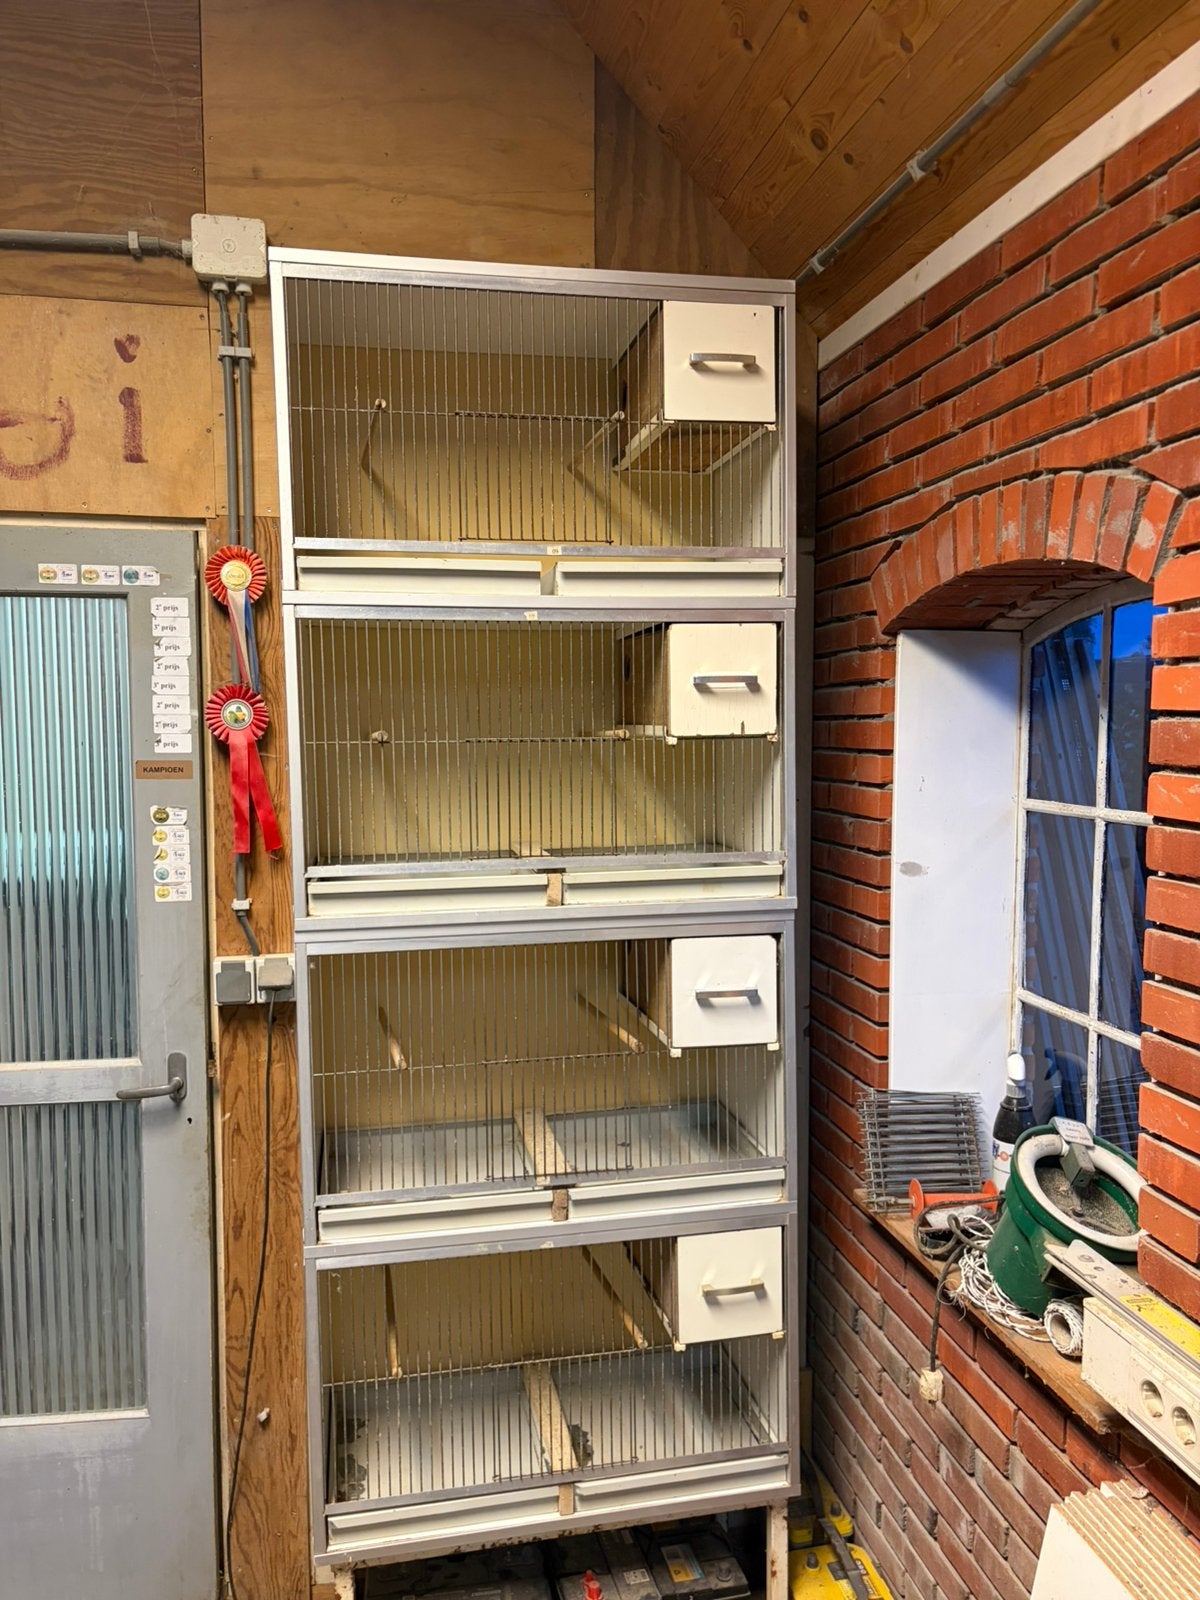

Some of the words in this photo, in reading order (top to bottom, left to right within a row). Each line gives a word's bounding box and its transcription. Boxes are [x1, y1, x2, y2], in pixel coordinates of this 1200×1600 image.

[163, 604, 179, 613] prijs
[161, 625, 177, 633] prijs
[164, 644, 181, 652] prijs
[164, 663, 180, 671] prijs
[160, 682, 176, 690] prijs
[164, 702, 180, 710] prijs
[162, 721, 178, 729] prijs
[163, 741, 179, 749] prijs
[142, 766, 184, 774] KAMPIOEN
